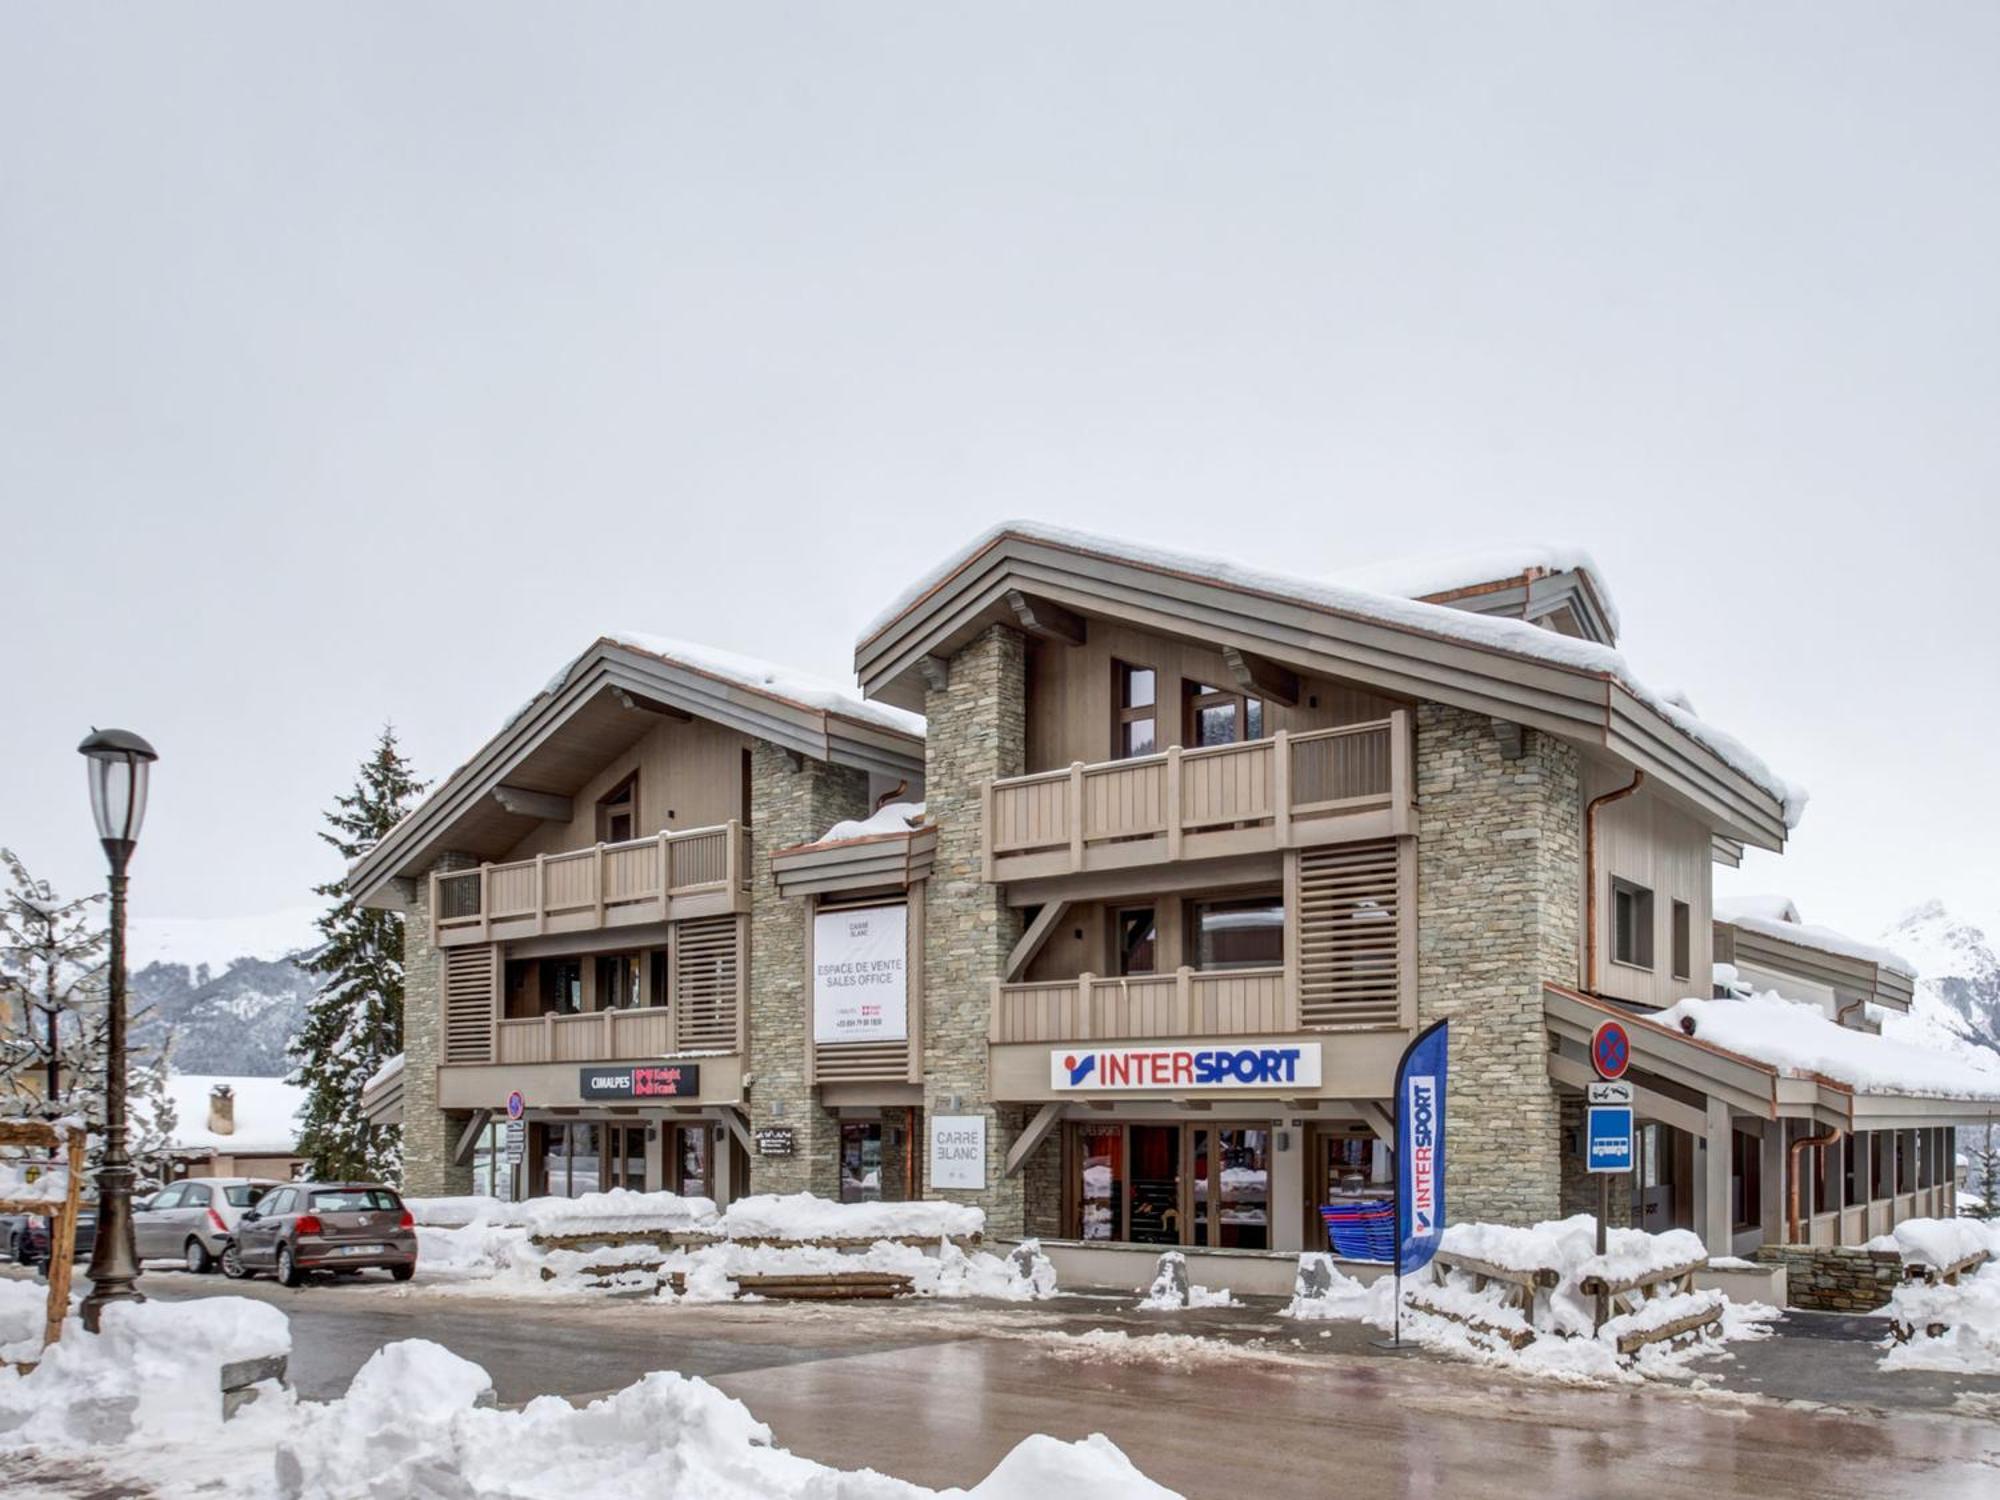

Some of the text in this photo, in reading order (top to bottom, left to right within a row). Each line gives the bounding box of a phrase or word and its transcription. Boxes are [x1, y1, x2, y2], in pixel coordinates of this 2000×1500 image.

[818, 959, 902, 976] ESPACE DE VENTE
[827, 973, 893, 987] SALES OFFICE
[1100, 1049, 1300, 1086] INTERSPORT
[591, 1076, 630, 1089] CIMALPES
[1414, 1085, 1433, 1208] INTERSPORT
